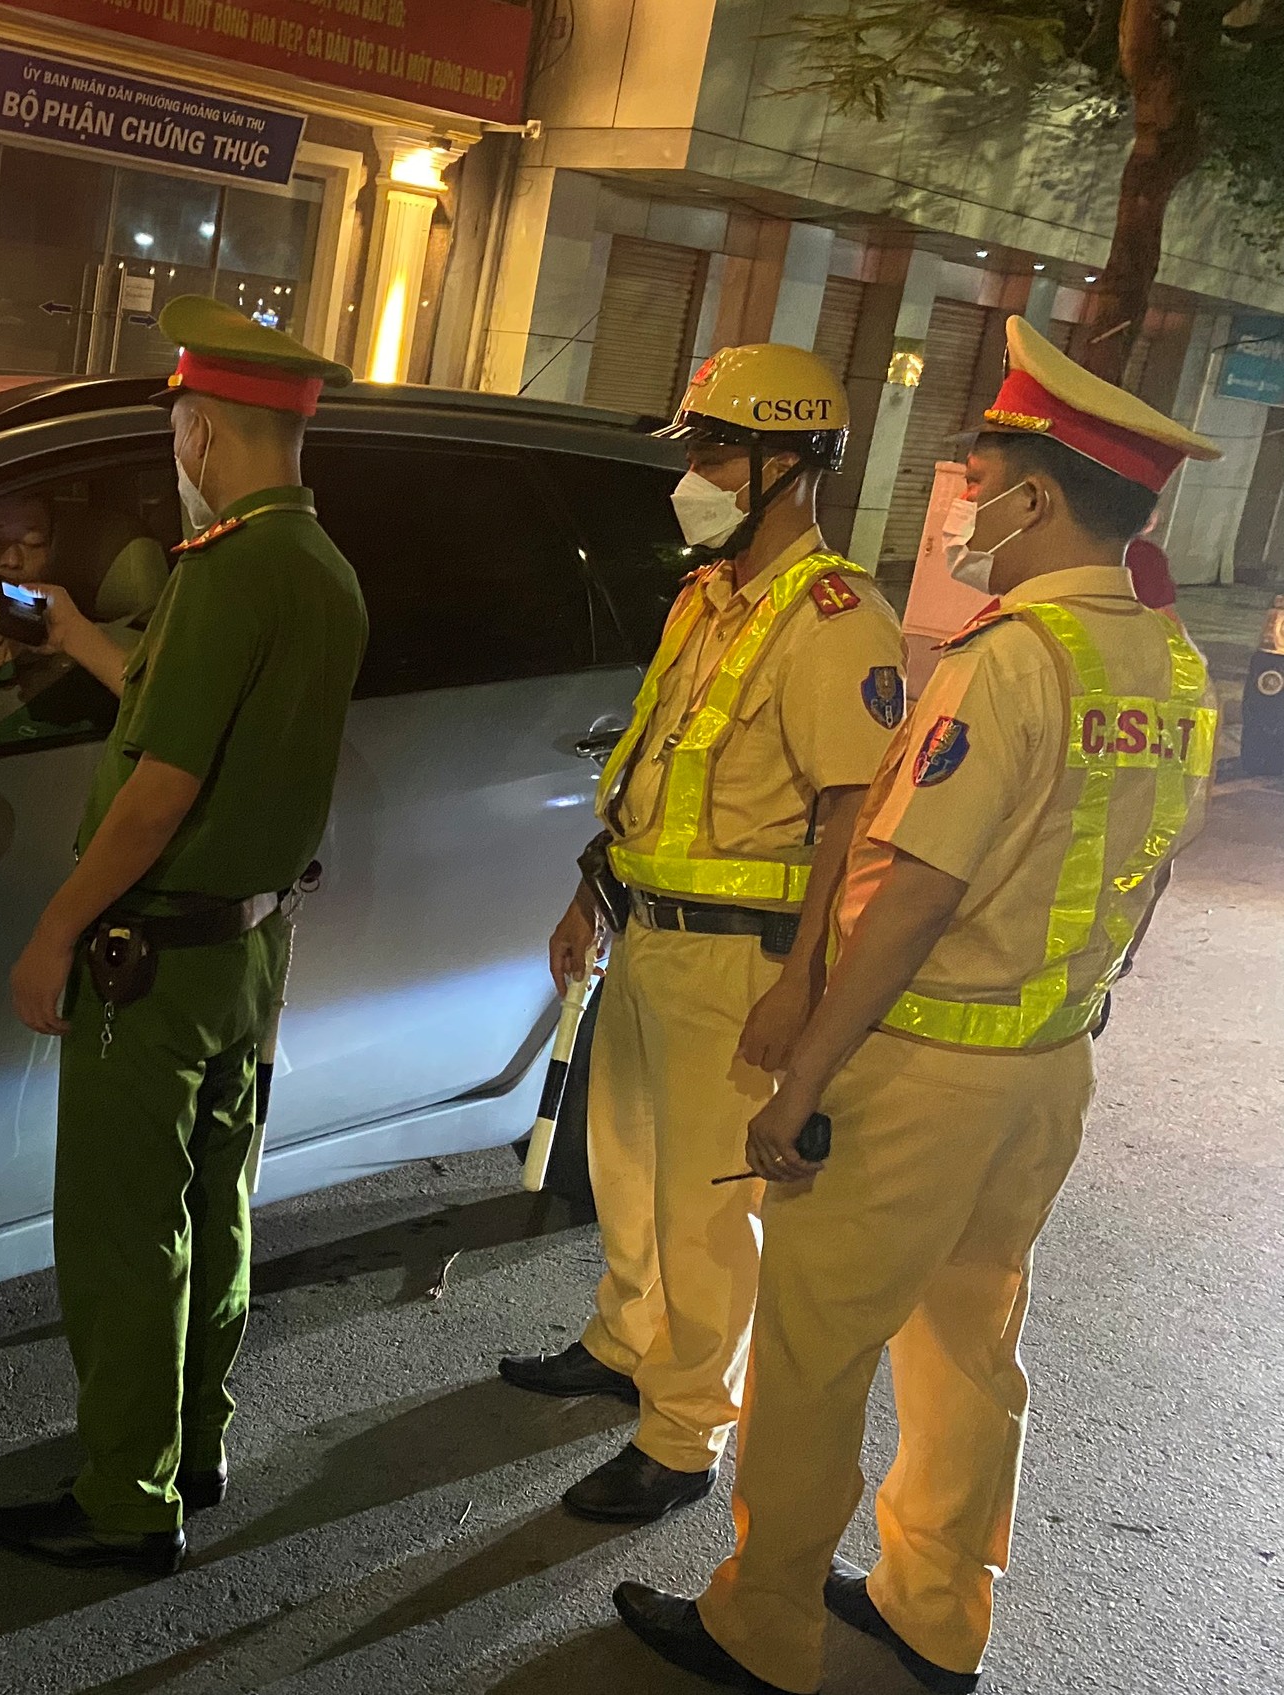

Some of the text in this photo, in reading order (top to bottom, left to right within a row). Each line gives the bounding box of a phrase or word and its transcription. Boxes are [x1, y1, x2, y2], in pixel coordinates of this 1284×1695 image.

[252, 12, 276, 46] HOA
[43, 71, 69, 88] BAN
[71, 77, 106, 96] NHÂN
[107, 85, 133, 102] DÂN
[134, 92, 181, 113] PHƯỜNG
[182, 102, 220, 121] HOÀNG
[246, 116, 266, 134] THỤ
[2, 89, 270, 171] BỘ PHẬN CHỨNG THỰC
[753, 399, 832, 421] CSGT
[1082, 709, 1196, 762] C.S..T
